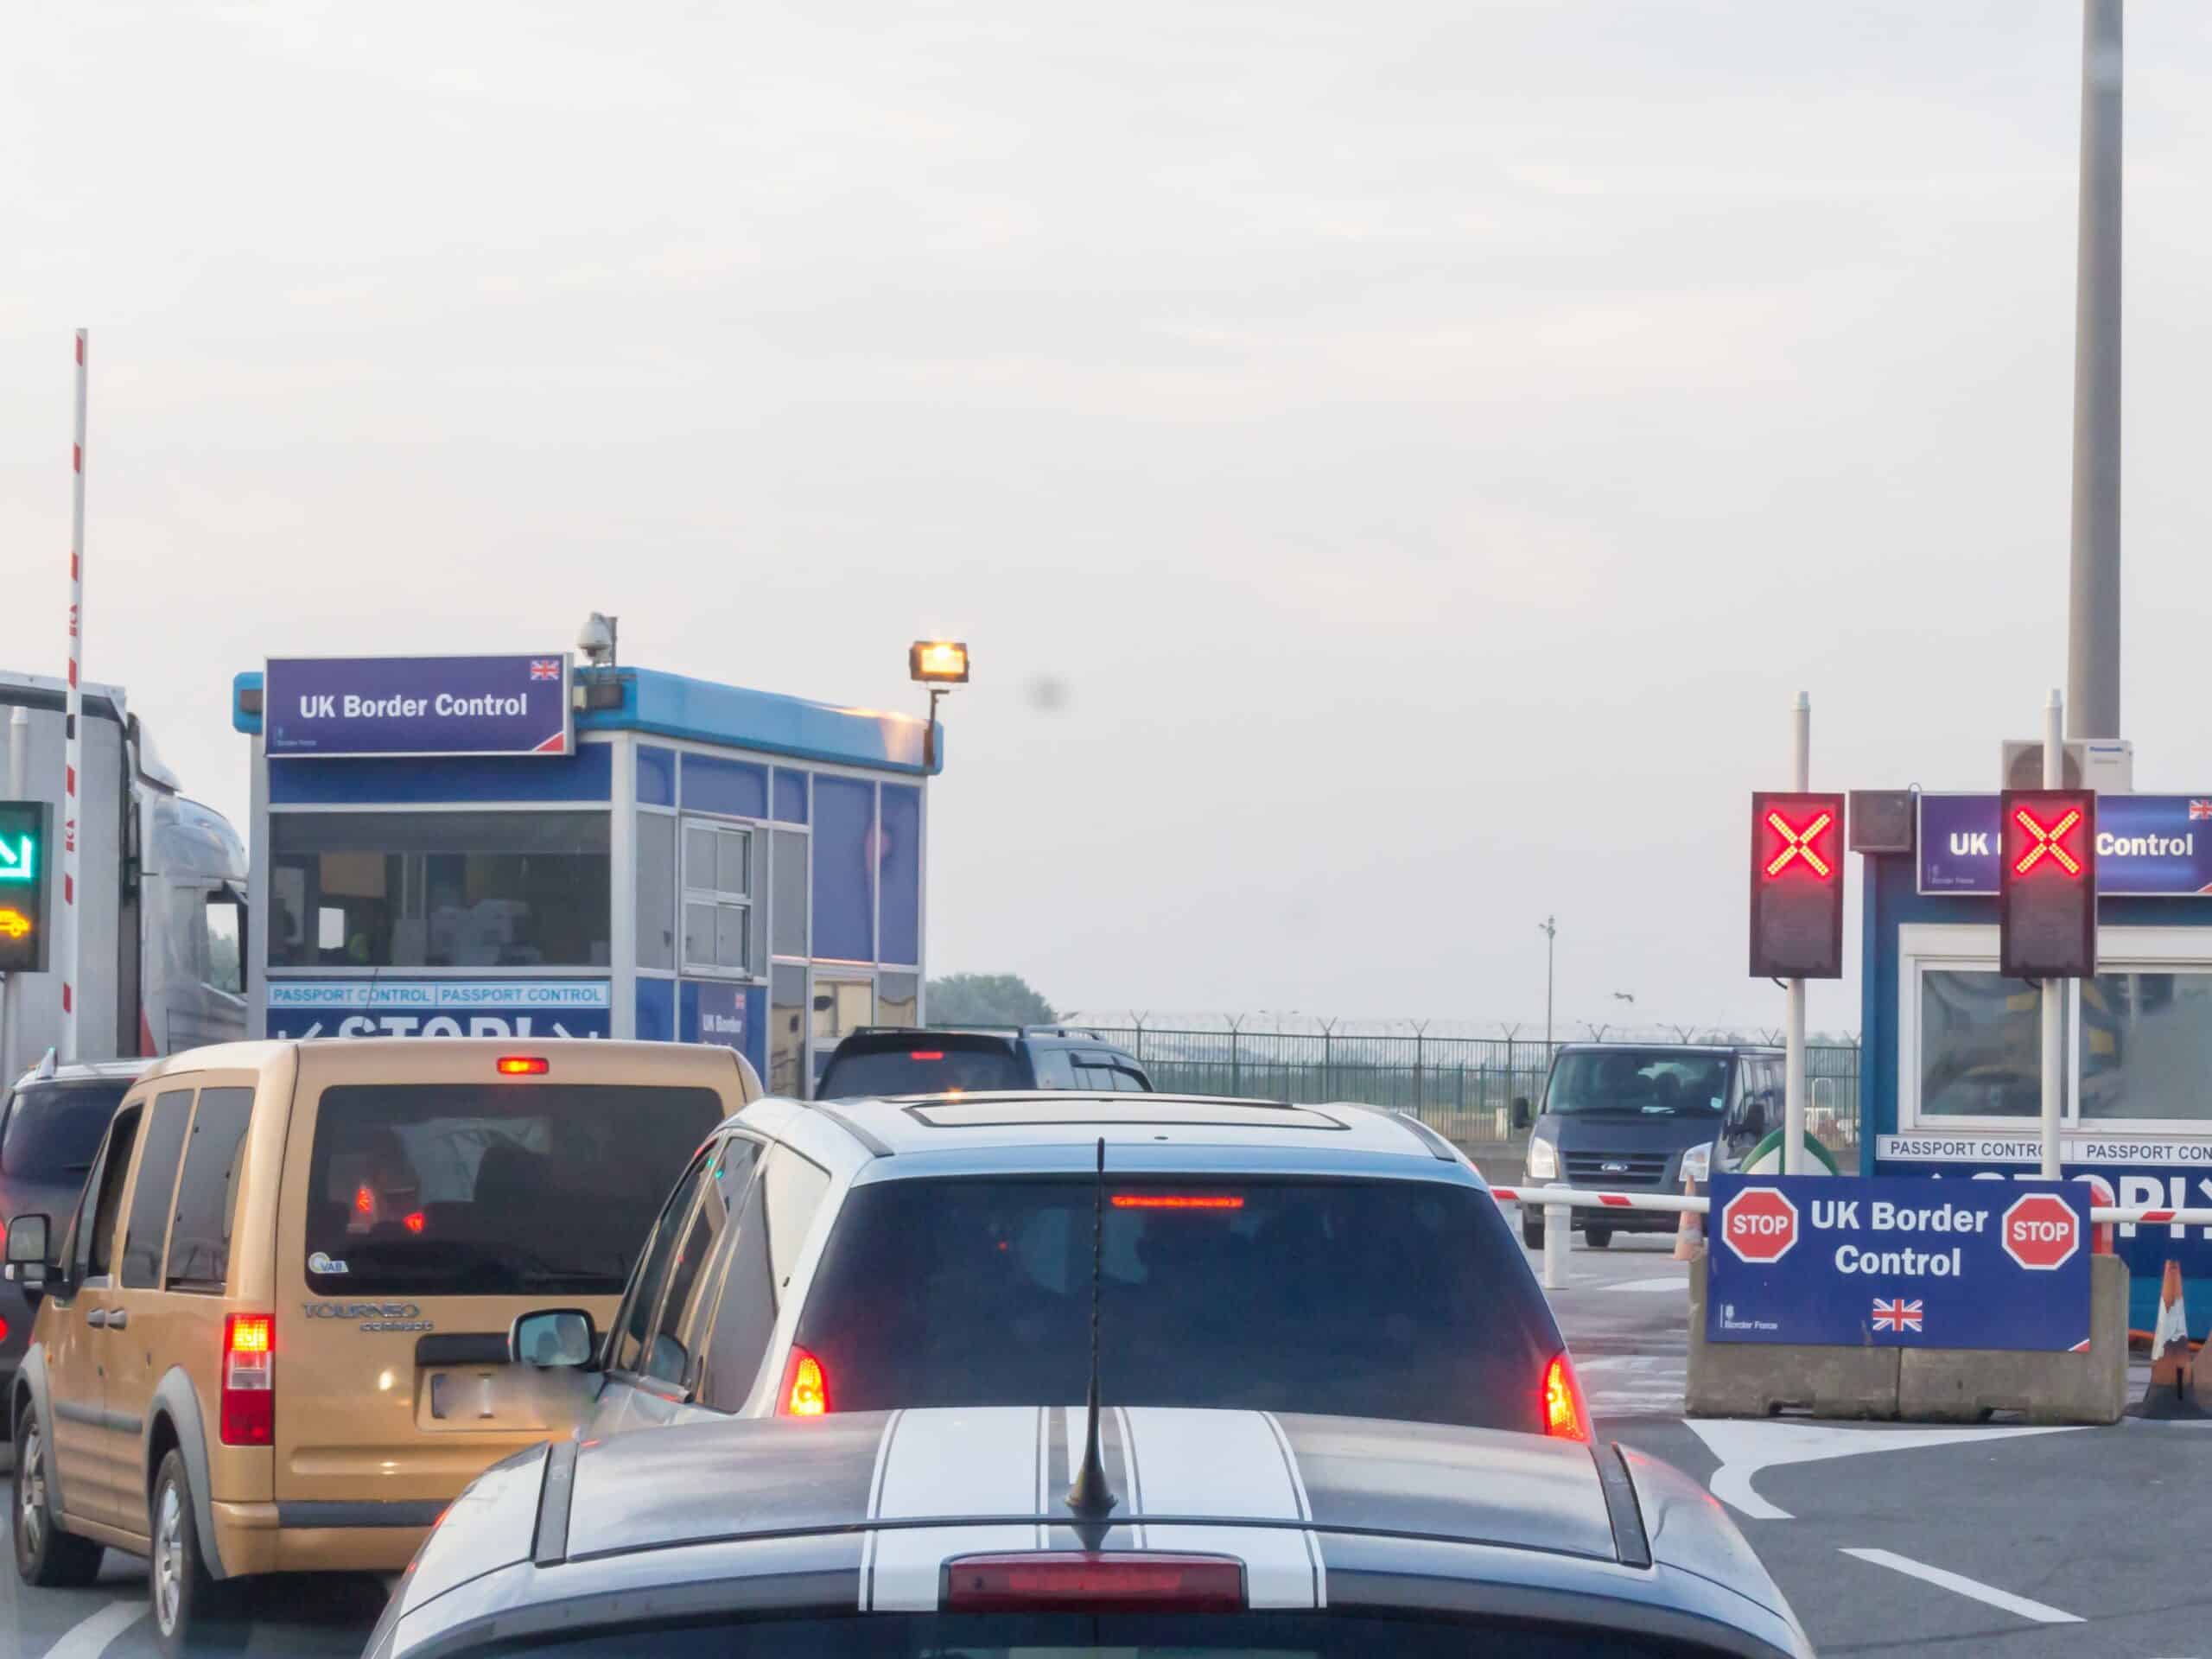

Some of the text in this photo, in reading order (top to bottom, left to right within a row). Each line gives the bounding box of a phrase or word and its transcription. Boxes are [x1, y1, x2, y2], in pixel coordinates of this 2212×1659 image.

[299, 692, 527, 719] UK Border Control
[1949, 832, 1989, 856] UK
[2094, 832, 2194, 857] Control
[273, 988, 430, 1002] PASSPORT CONTROL
[442, 988, 602, 1002] PASSPORT CONTROL
[1890, 1140, 1976, 1156] PASSPORT
[2086, 1144, 2173, 1160] PASSPORT
[1732, 1214, 1789, 1236] STOP
[1810, 1199, 1988, 1233] UK Border
[2012, 1221, 2069, 1243] STOP
[1834, 1243, 1961, 1277] Control
[302, 1301, 421, 1319] TOURNEO
